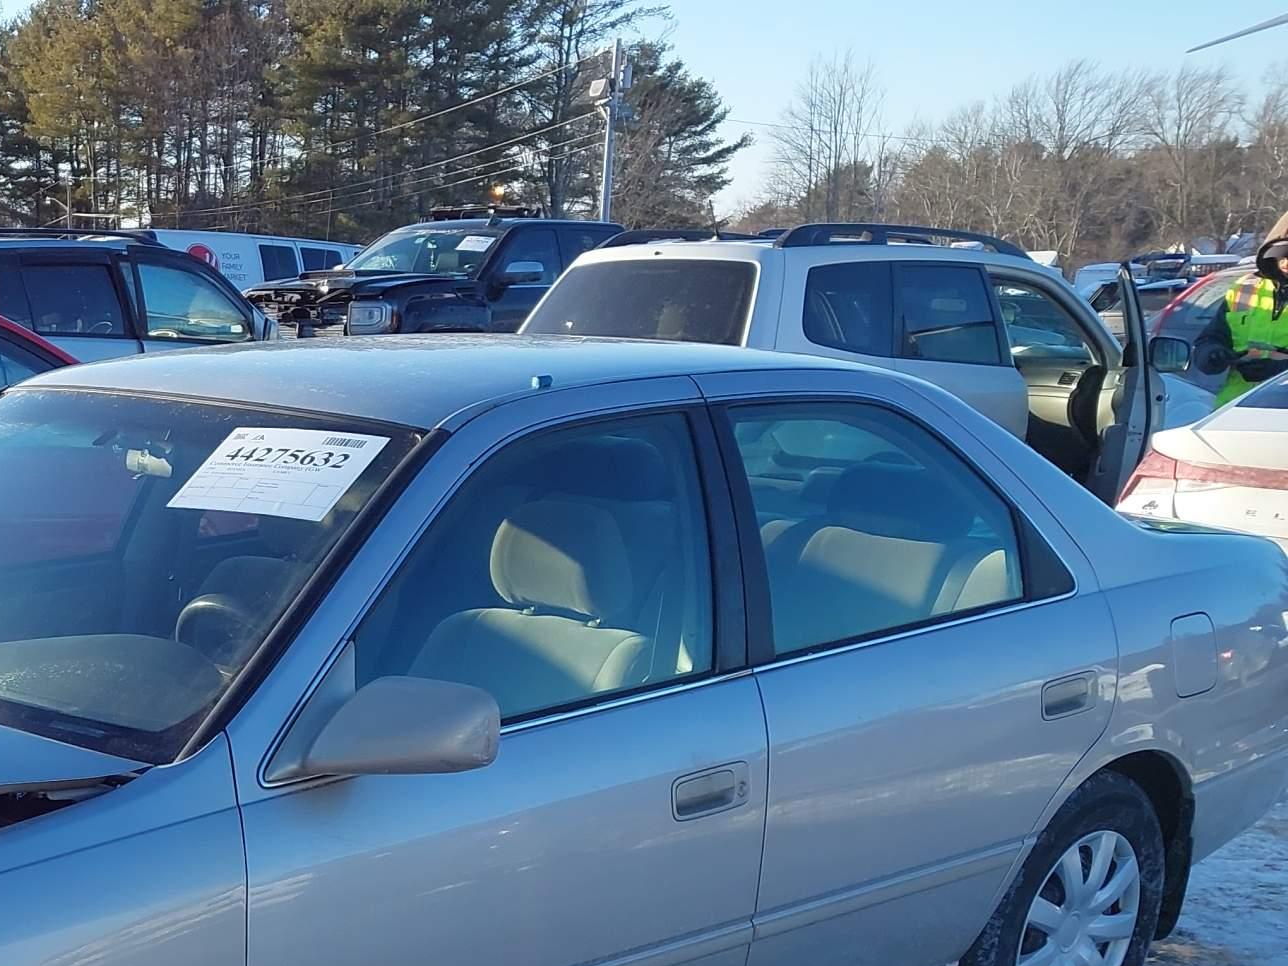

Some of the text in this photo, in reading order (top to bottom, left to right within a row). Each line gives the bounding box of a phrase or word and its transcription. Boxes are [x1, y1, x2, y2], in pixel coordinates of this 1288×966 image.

[222, 253, 240, 261] YOUR
[222, 263, 243, 271] FAMILY
[225, 446, 350, 469] 44275632
